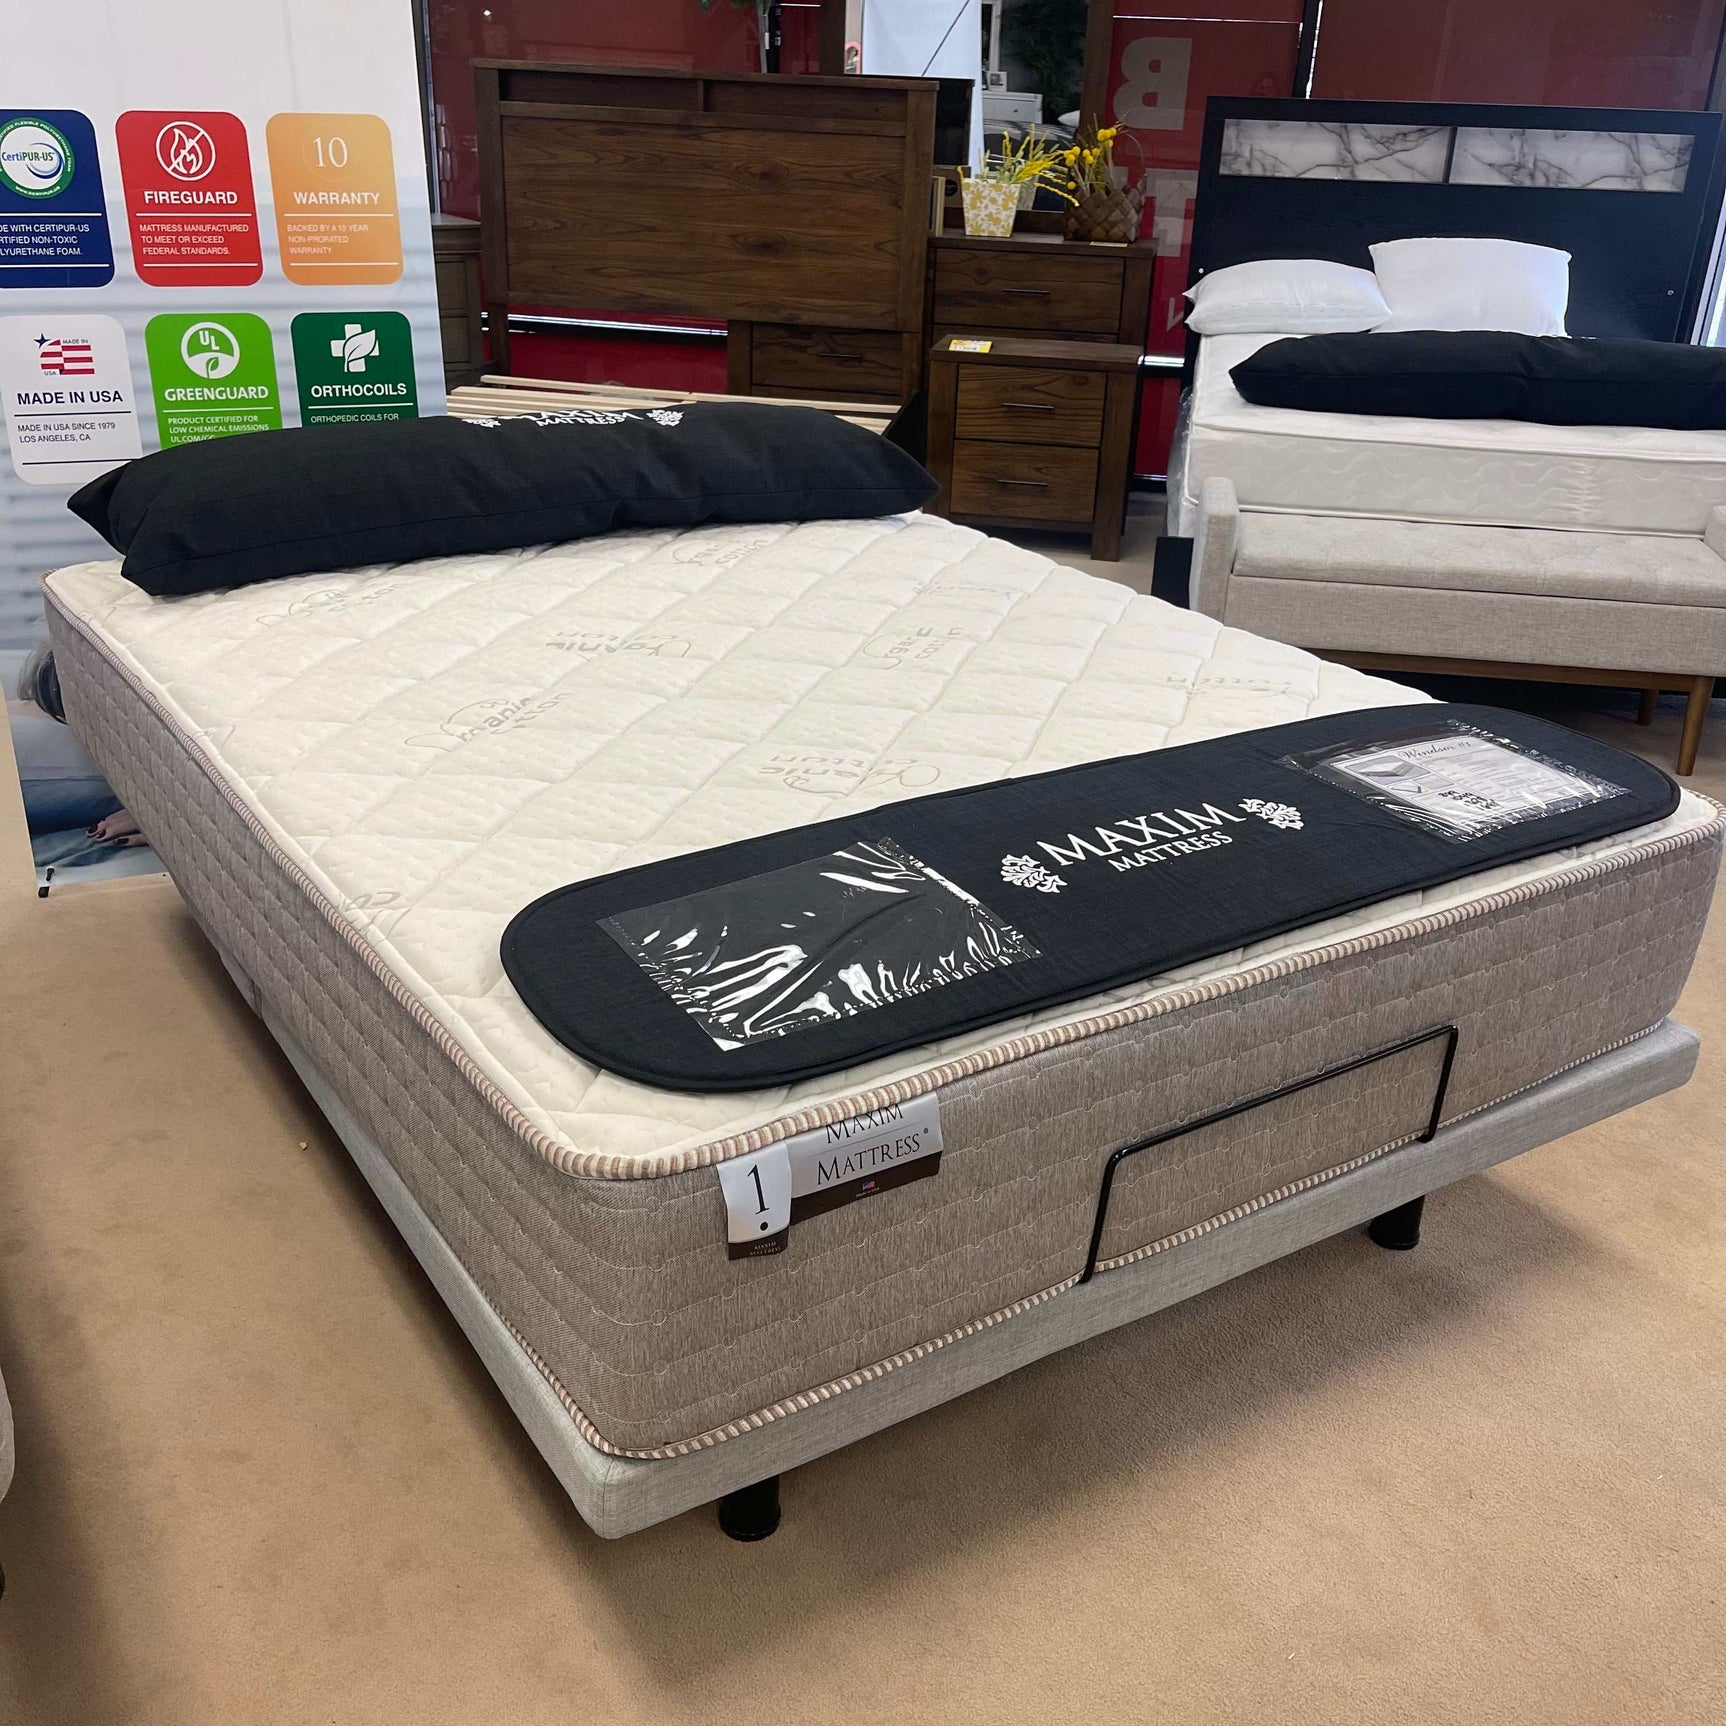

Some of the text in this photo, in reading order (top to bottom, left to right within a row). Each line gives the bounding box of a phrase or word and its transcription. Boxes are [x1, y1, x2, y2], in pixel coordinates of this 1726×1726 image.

[2, 151, 54, 161] CertiPUR-US
[313, 136, 348, 168] 10
[143, 190, 238, 204] FIREGUARD
[293, 191, 380, 205] WARRANTY
[10, 224, 32, 232] WITH
[34, 224, 90, 232] CERTIPUR-US
[140, 224, 249, 232] MATTRESS MANUFACTURED
[286, 224, 318, 232] BACKED
[320, 224, 330, 232] BY
[32, 236, 78, 244] NON-TOXIC
[288, 235, 349, 243] NON-PRORATED
[0, 247, 55, 256] LYURETHANE
[143, 247, 231, 255] FEDERAL STANDARDS.
[289, 247, 332, 255] WARRANTY
[198, 330, 220, 351] UL
[164, 385, 269, 401] GREENGUARD
[310, 382, 407, 398] ORTHOCOILS
[16, 390, 124, 405] MADE IN USA
[168, 416, 204, 425] PRODUCT
[206, 415, 242, 423] CERTIFIED
[310, 414, 360, 423] ORTHOPEDIC
[360, 413, 382, 421] COILS
[536, 416, 626, 427] MATTRESS
[18, 422, 116, 432] MADE IN USA SINCE 1979
[169, 424, 270, 434] LOW CHEMICAL EMISSIONS
[20, 433, 92, 443] LOS ANGELES, CA
[1036, 802, 1247, 866] MAXIM
[1108, 831, 1234, 872] MATTRESS
[825, 1103, 904, 1144] MAXIM
[816, 1133, 921, 1186] MATTRESS
